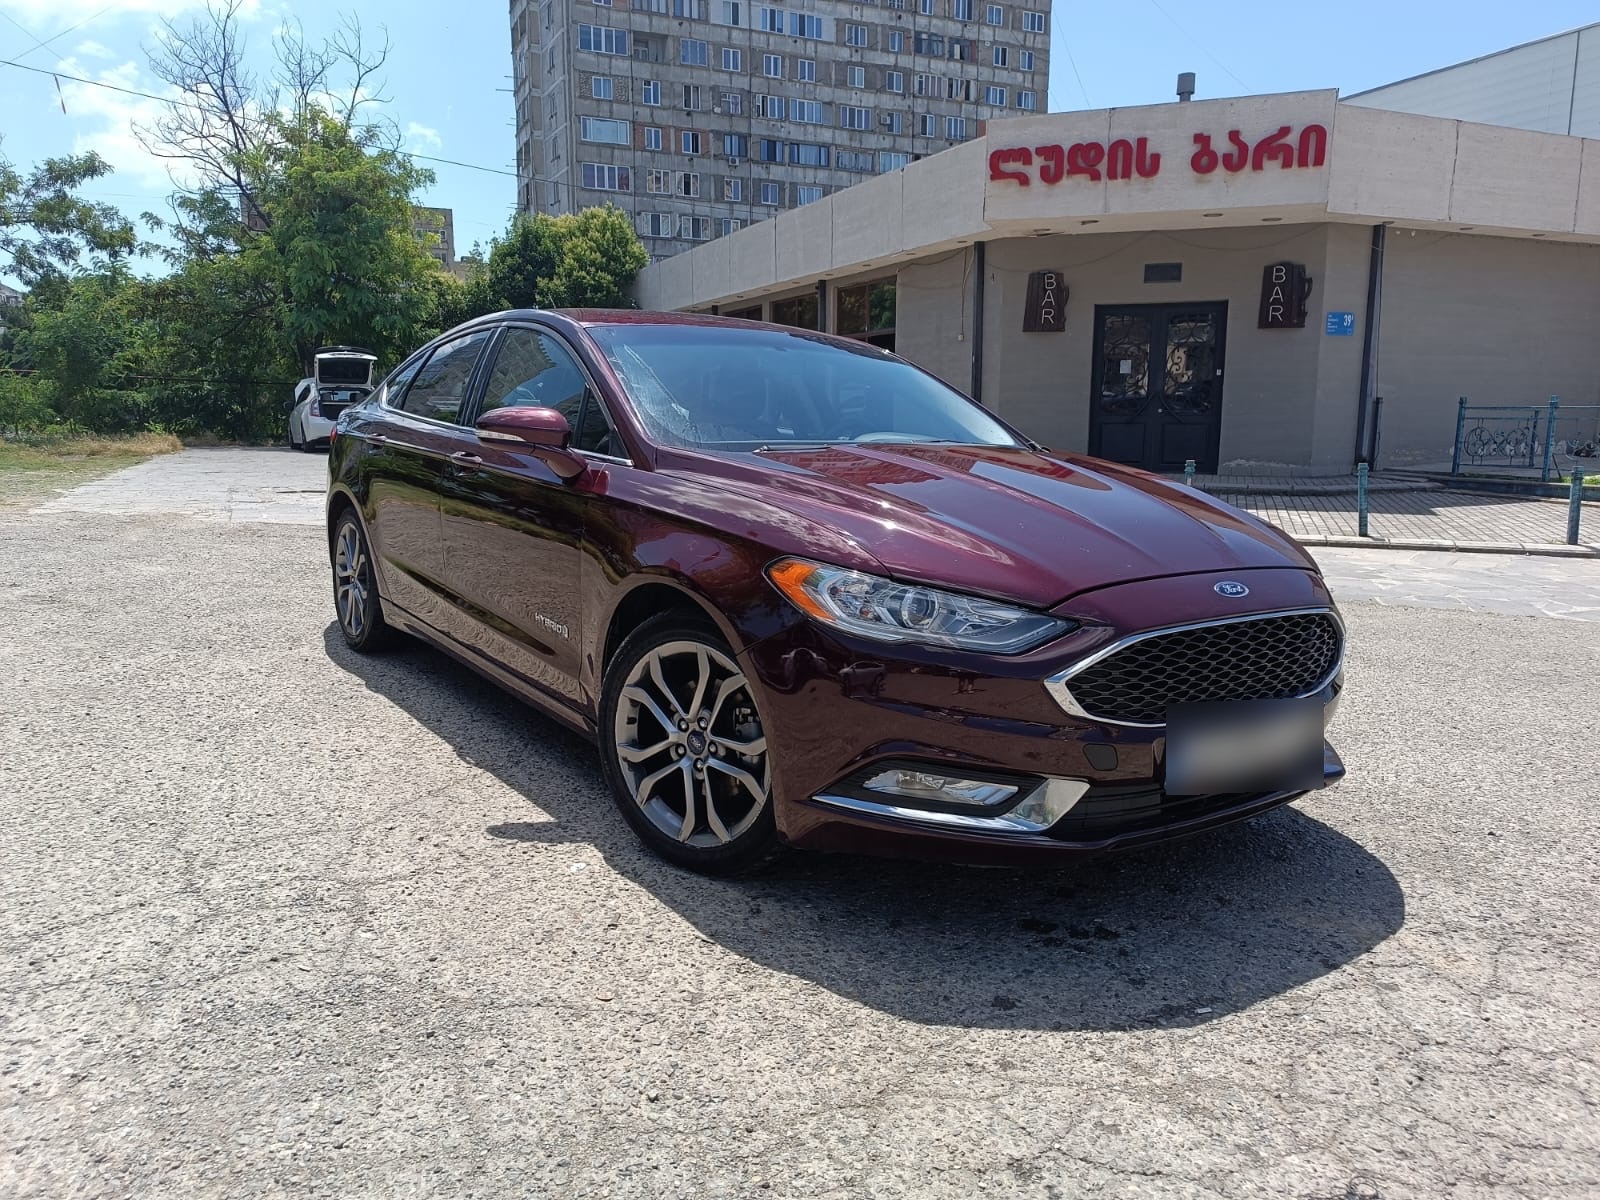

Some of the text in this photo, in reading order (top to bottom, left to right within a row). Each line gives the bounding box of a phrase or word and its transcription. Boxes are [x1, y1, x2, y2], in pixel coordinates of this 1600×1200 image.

[989, 124, 1328, 187] ლუდის ბარი
[1041, 273, 1057, 324] BAR
[1269, 265, 1286, 322] BAR
